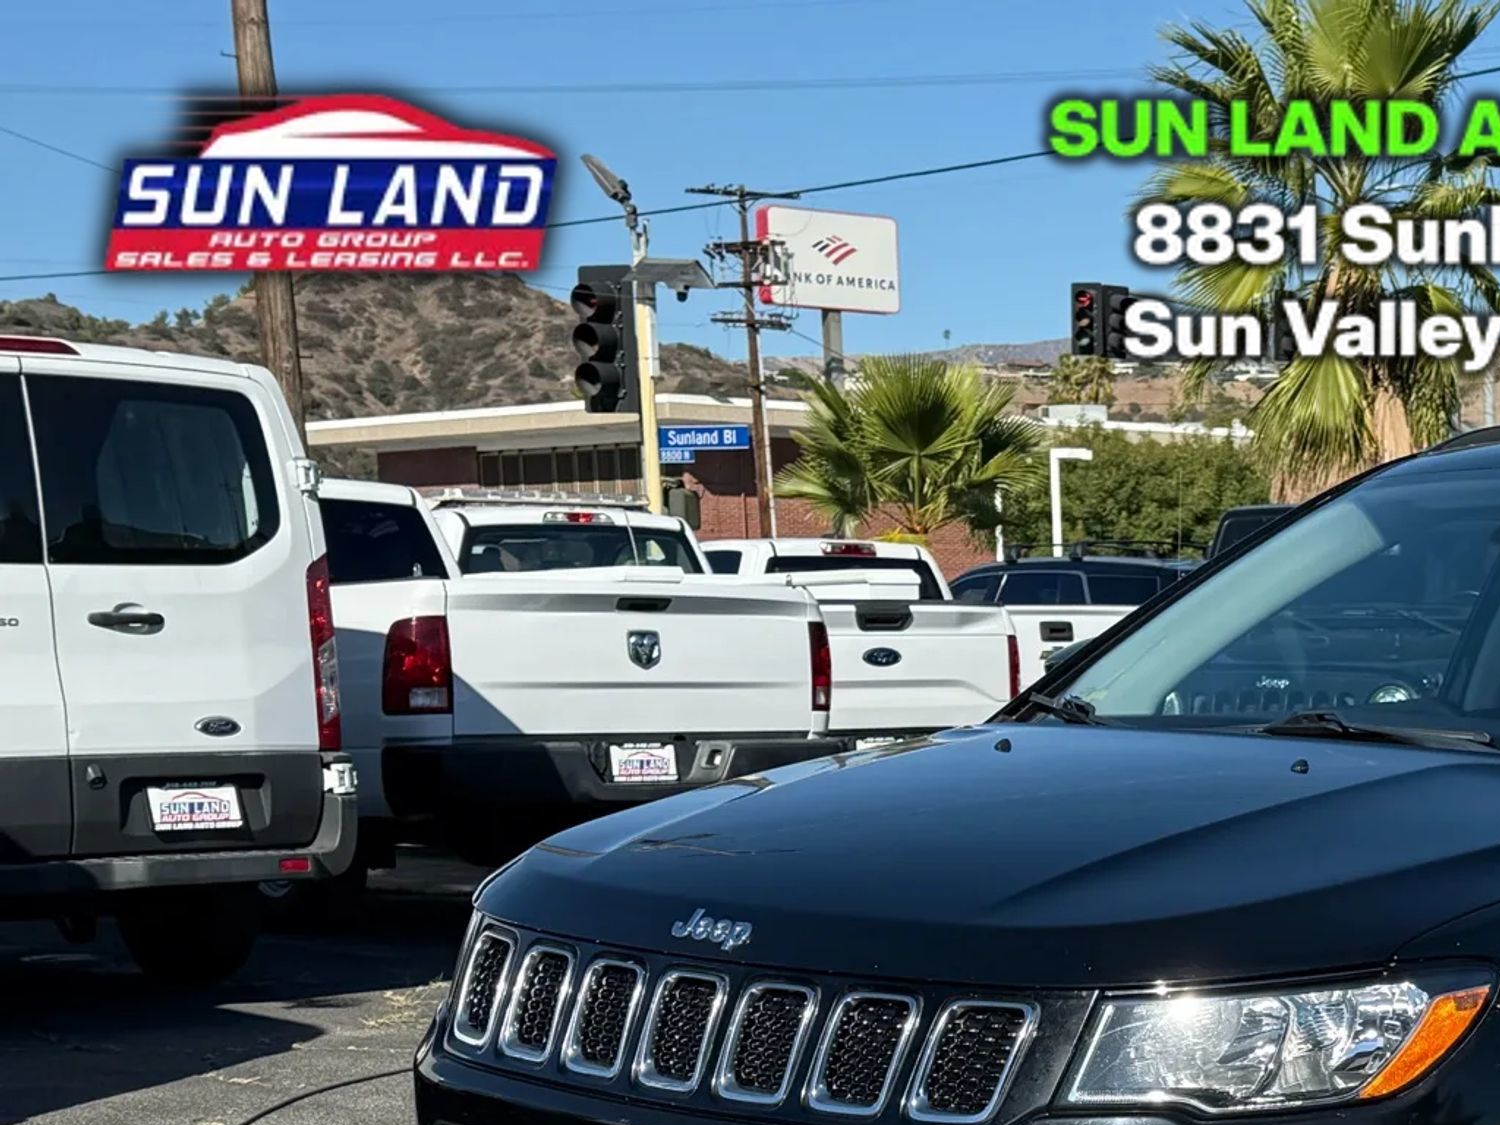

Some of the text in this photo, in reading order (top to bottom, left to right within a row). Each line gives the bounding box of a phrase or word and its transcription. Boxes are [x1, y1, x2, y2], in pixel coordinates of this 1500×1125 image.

[816, 273, 833, 286] OF
[836, 274, 896, 291] AMERICA
[667, 429, 737, 446] Sunland Bl
[1255, 675, 1290, 688] Jeep
[161, 800, 231, 814] SUN LAND
[161, 813, 190, 823] AUTO
[671, 907, 753, 951] Jeep
